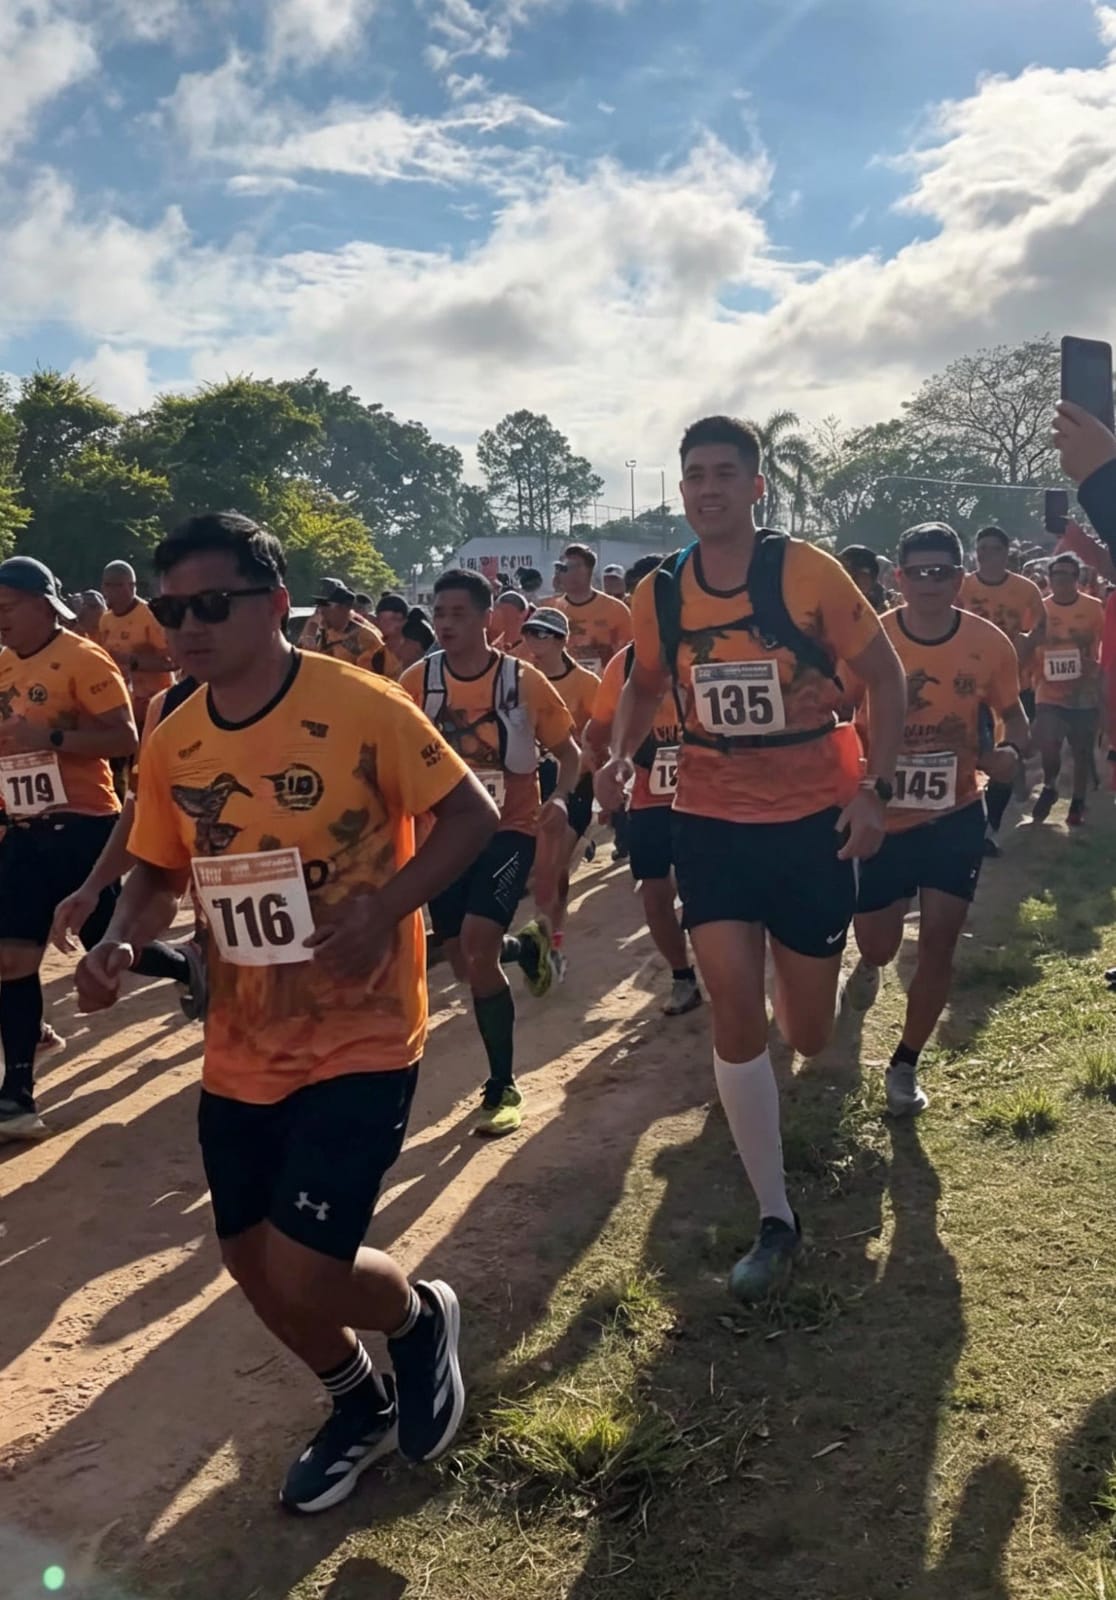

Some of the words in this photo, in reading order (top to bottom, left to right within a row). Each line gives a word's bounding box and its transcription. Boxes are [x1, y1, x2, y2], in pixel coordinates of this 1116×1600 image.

[703, 685, 774, 725] 135
[7, 773, 55, 806] 119
[895, 770, 947, 801] 145
[212, 893, 295, 948] 116
